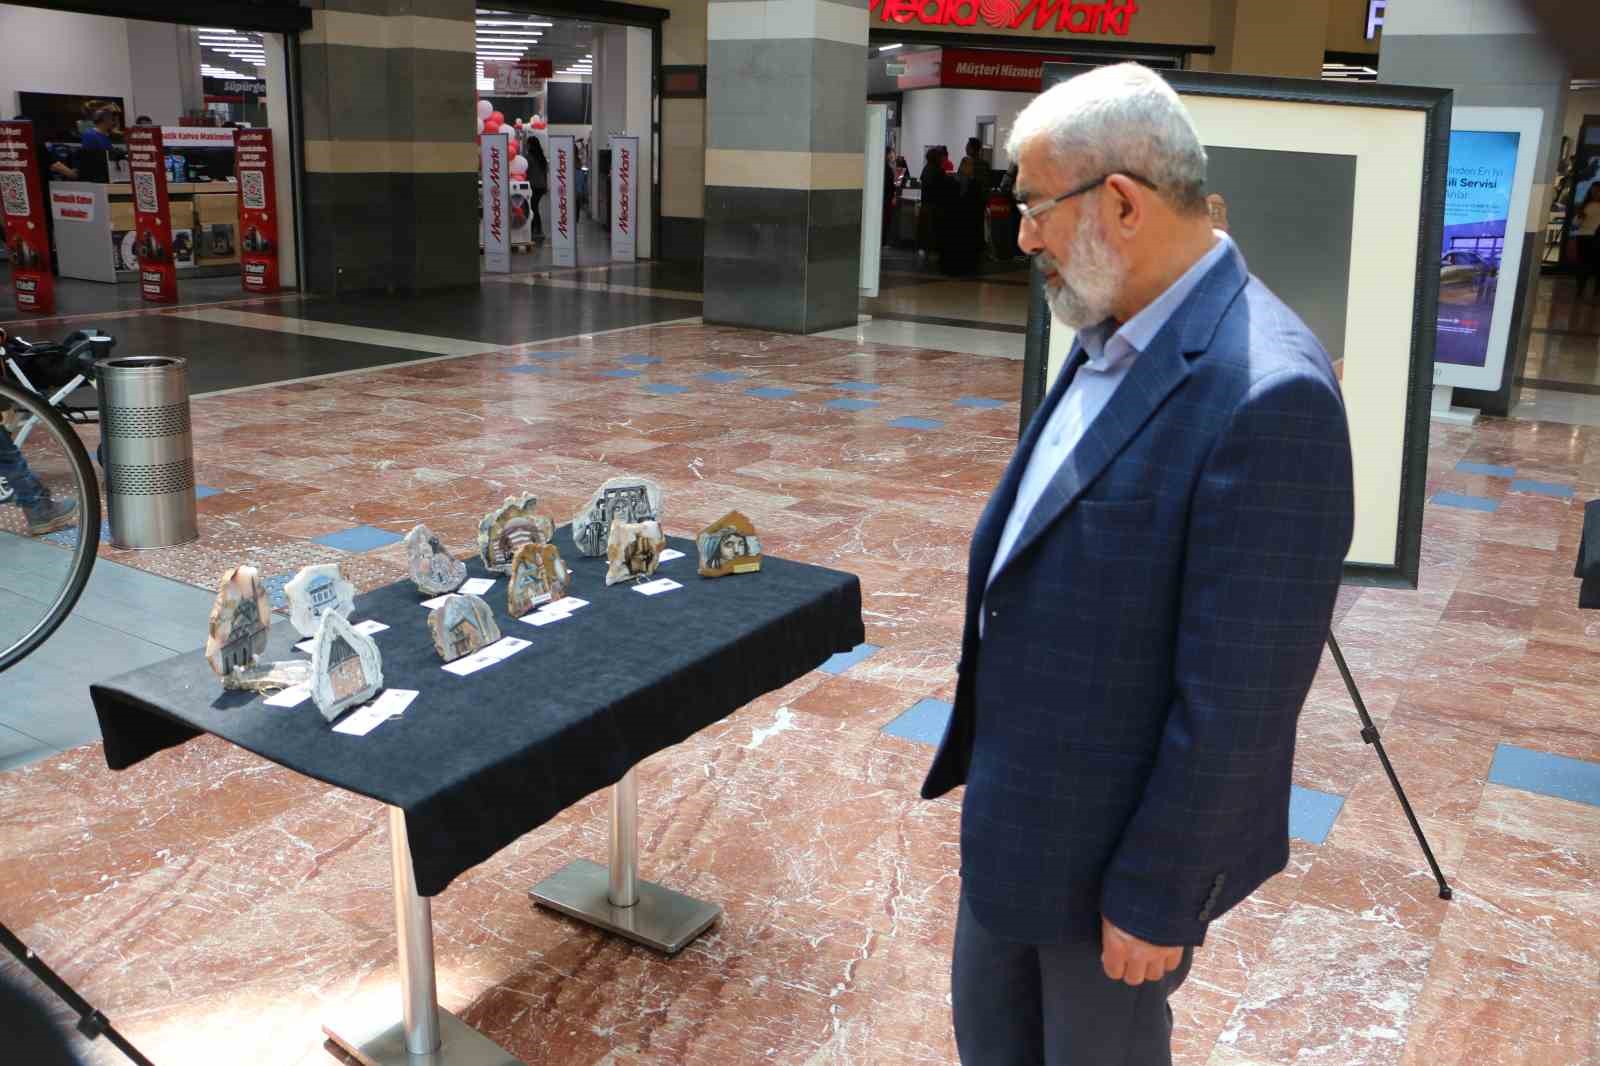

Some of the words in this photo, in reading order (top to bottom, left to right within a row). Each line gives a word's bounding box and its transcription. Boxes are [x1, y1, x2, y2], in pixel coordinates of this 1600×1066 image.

[1009, 0, 1138, 35] Markt
[956, 62, 1000, 77] Müşteri
[490, 145, 501, 188] Markt
[557, 147, 568, 185] Markt
[619, 147, 630, 184] Markt
[1460, 178, 1497, 189] Servisi
[490, 199, 501, 243] Media
[558, 198, 568, 240] Media
[618, 195, 629, 235] Media
